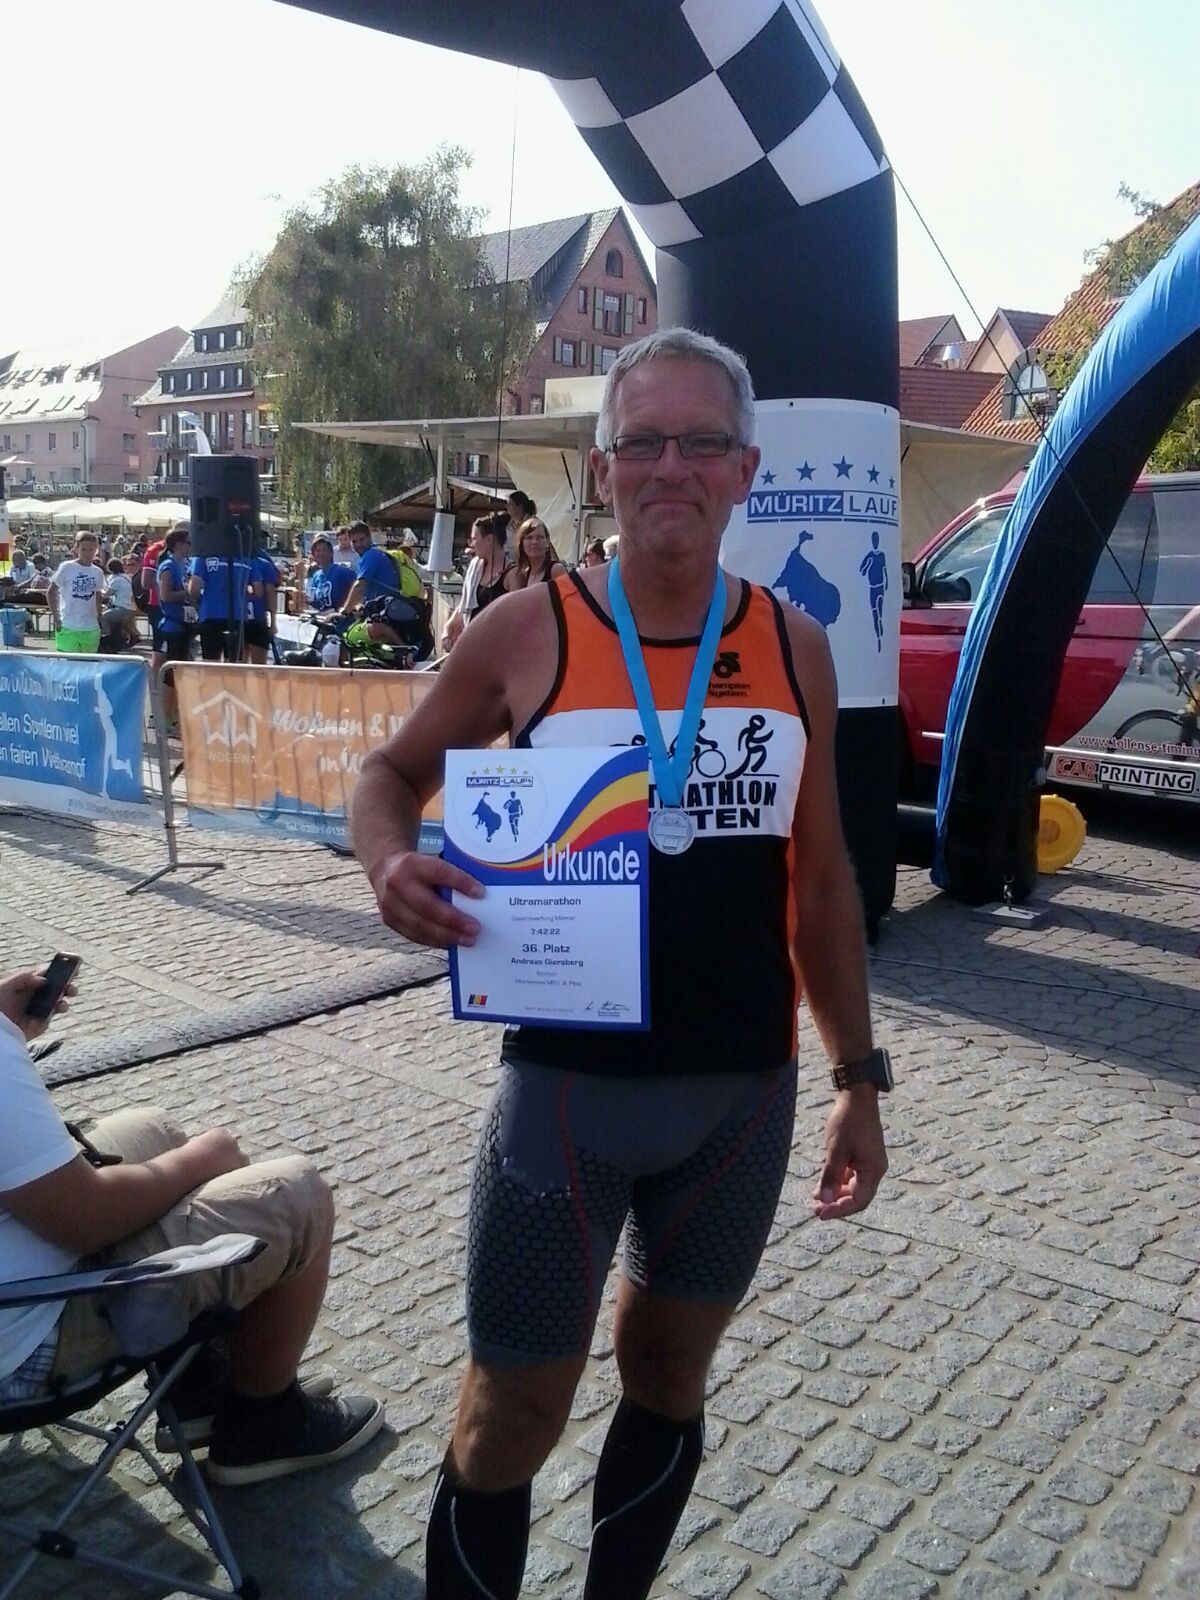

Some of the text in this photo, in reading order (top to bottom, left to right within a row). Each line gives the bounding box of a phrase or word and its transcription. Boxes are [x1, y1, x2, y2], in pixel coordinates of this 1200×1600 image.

[751, 493, 898, 517] MÜRITZ LAUF
[1059, 759, 1193, 790] CAR PRINTING
[648, 780, 777, 808] TATHLON
[543, 842, 640, 881] Urkunde
[509, 896, 581, 906] Ultramarathon
[543, 944, 571, 953] Platz
